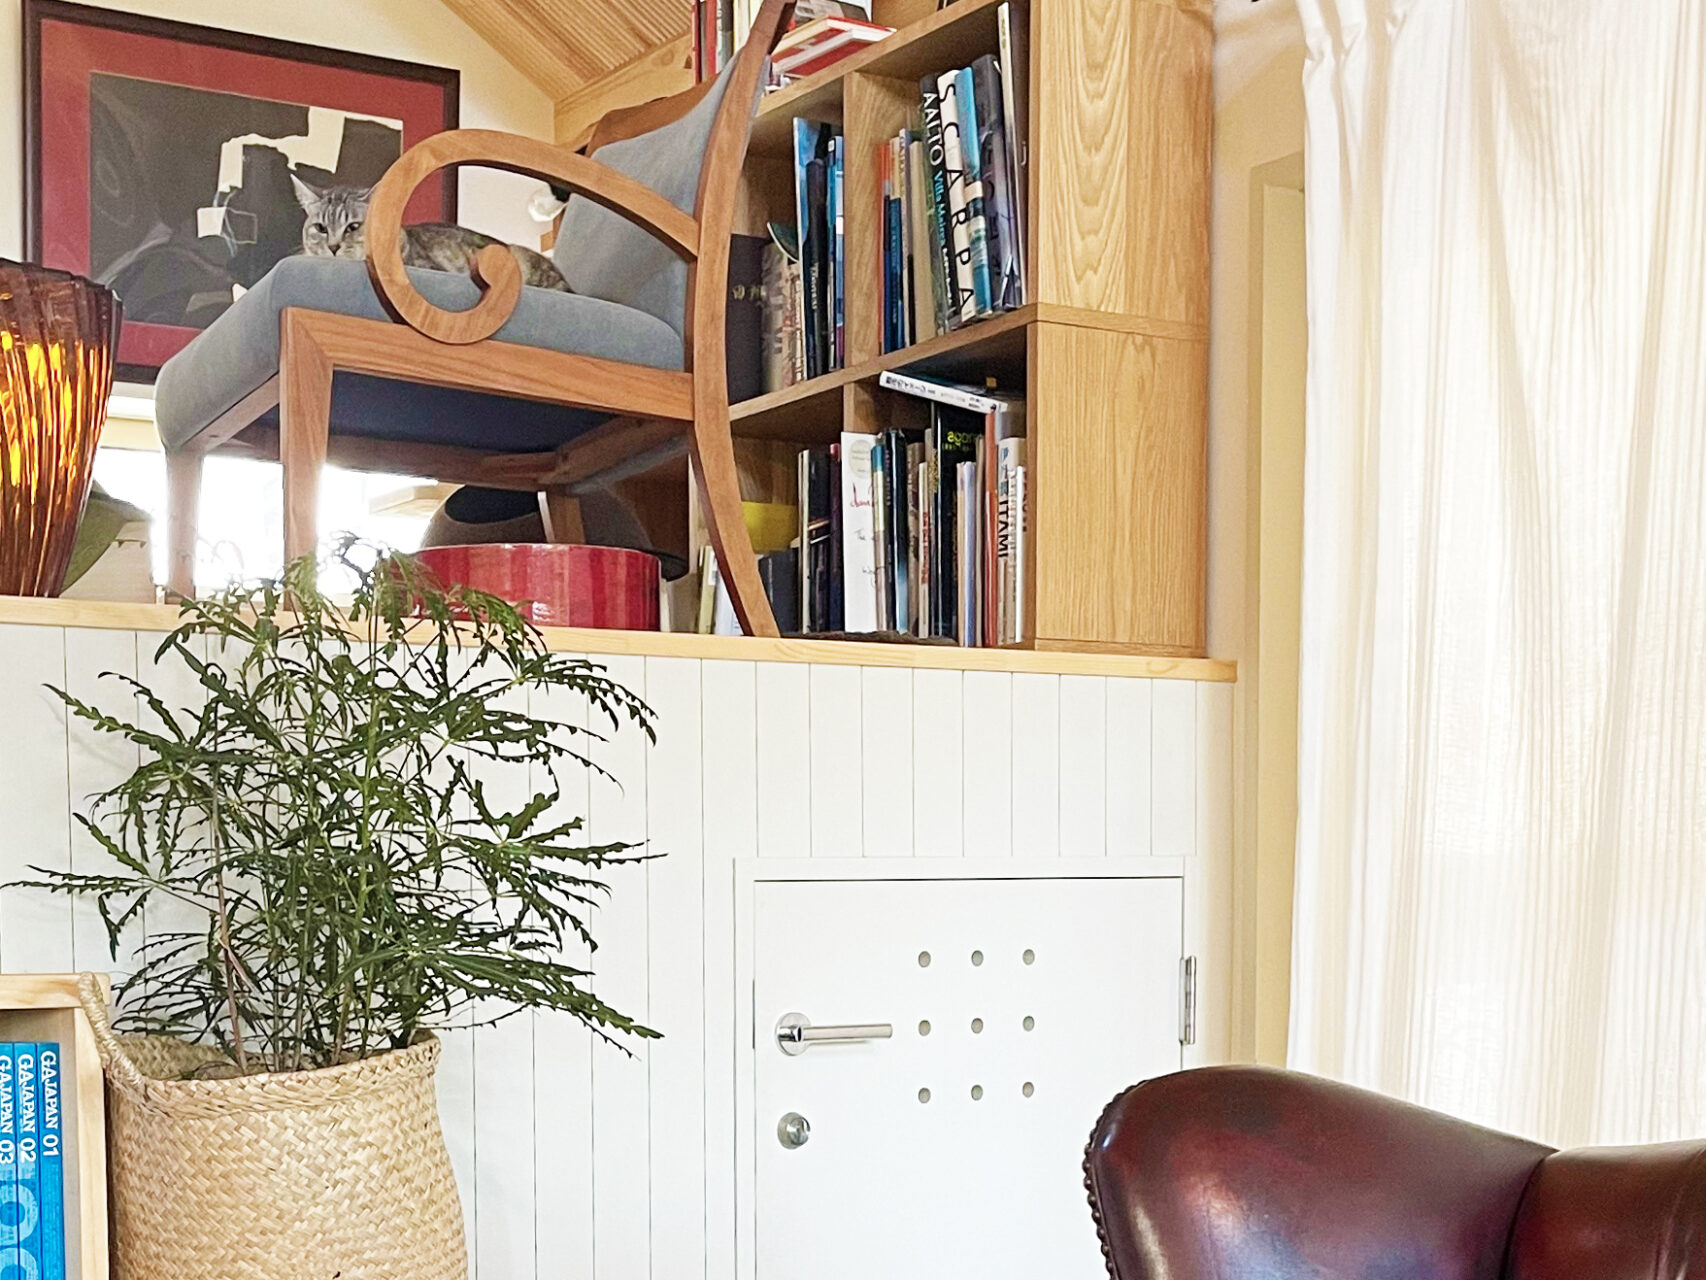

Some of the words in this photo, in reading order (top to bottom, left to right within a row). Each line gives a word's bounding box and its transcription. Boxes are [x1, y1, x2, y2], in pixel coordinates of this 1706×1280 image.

[923, 93, 944, 166] AALTO
[940, 83, 974, 308] SCARPA
[998, 500, 1009, 558] ITAMI
[20, 1137, 36, 1163] 02
[43, 1134, 60, 1156] 01
